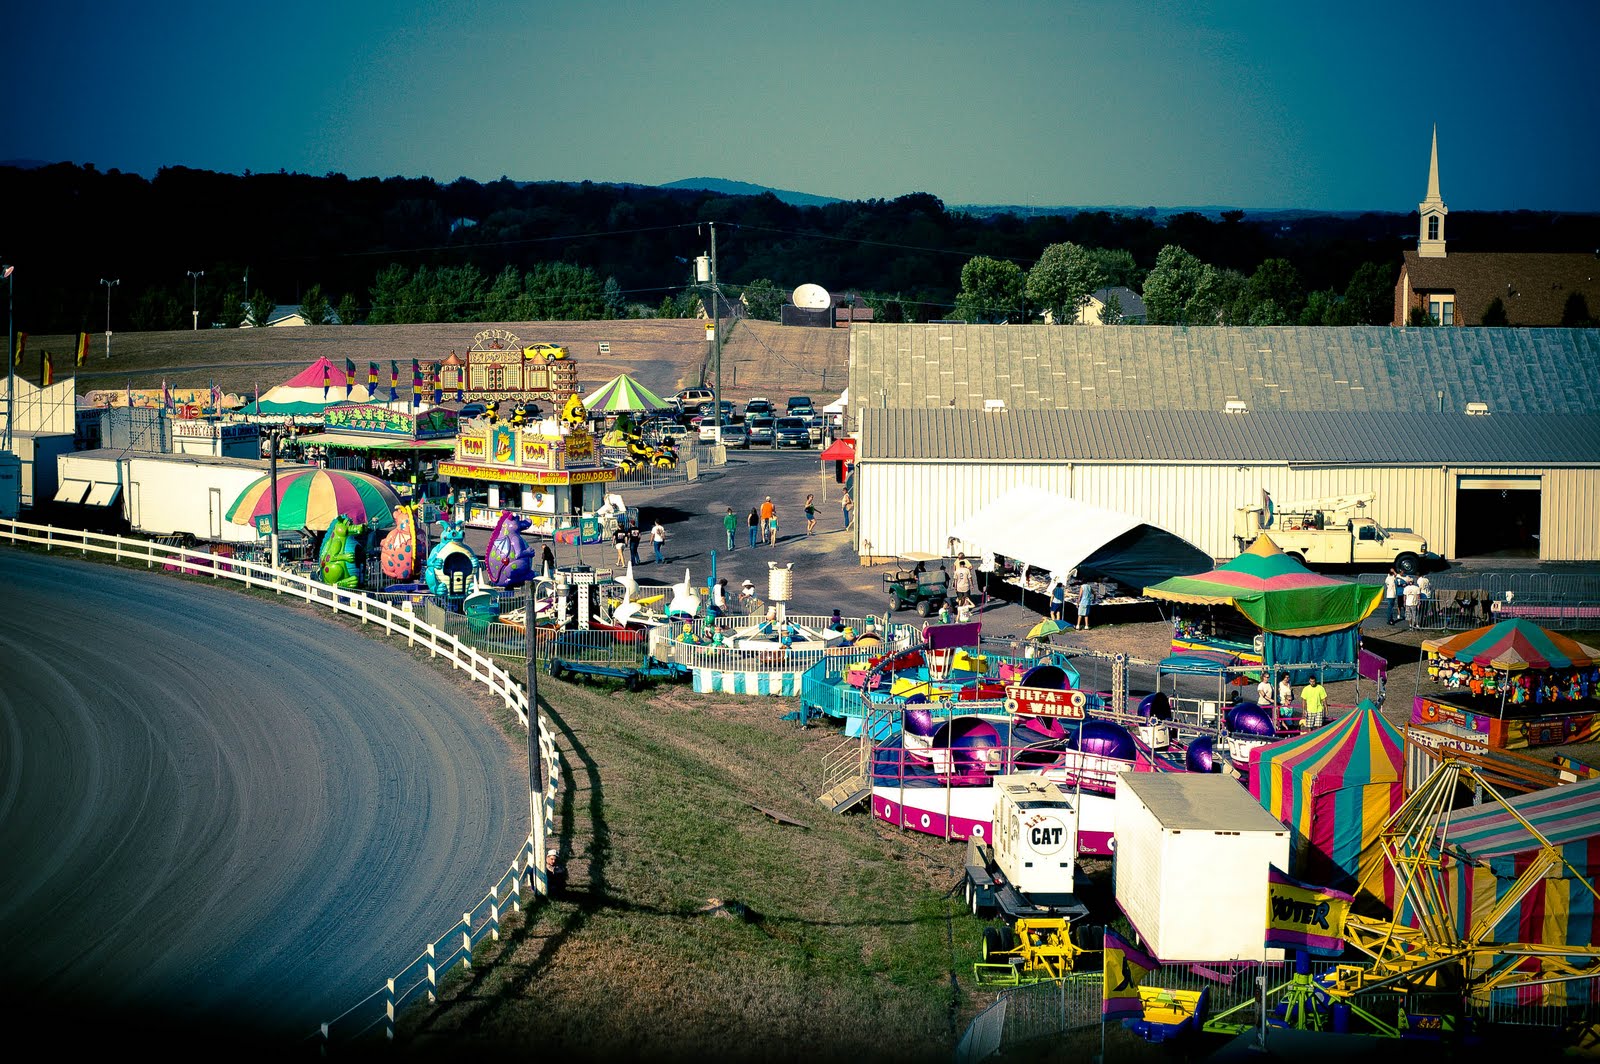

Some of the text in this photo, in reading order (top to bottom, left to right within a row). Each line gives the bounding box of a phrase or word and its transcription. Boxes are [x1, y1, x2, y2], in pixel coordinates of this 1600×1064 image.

[464, 438, 483, 456] FUN
[572, 471, 613, 482] CORN DOGS
[1030, 702, 1081, 717] WHIRL
[1032, 827, 1063, 845] CAT
